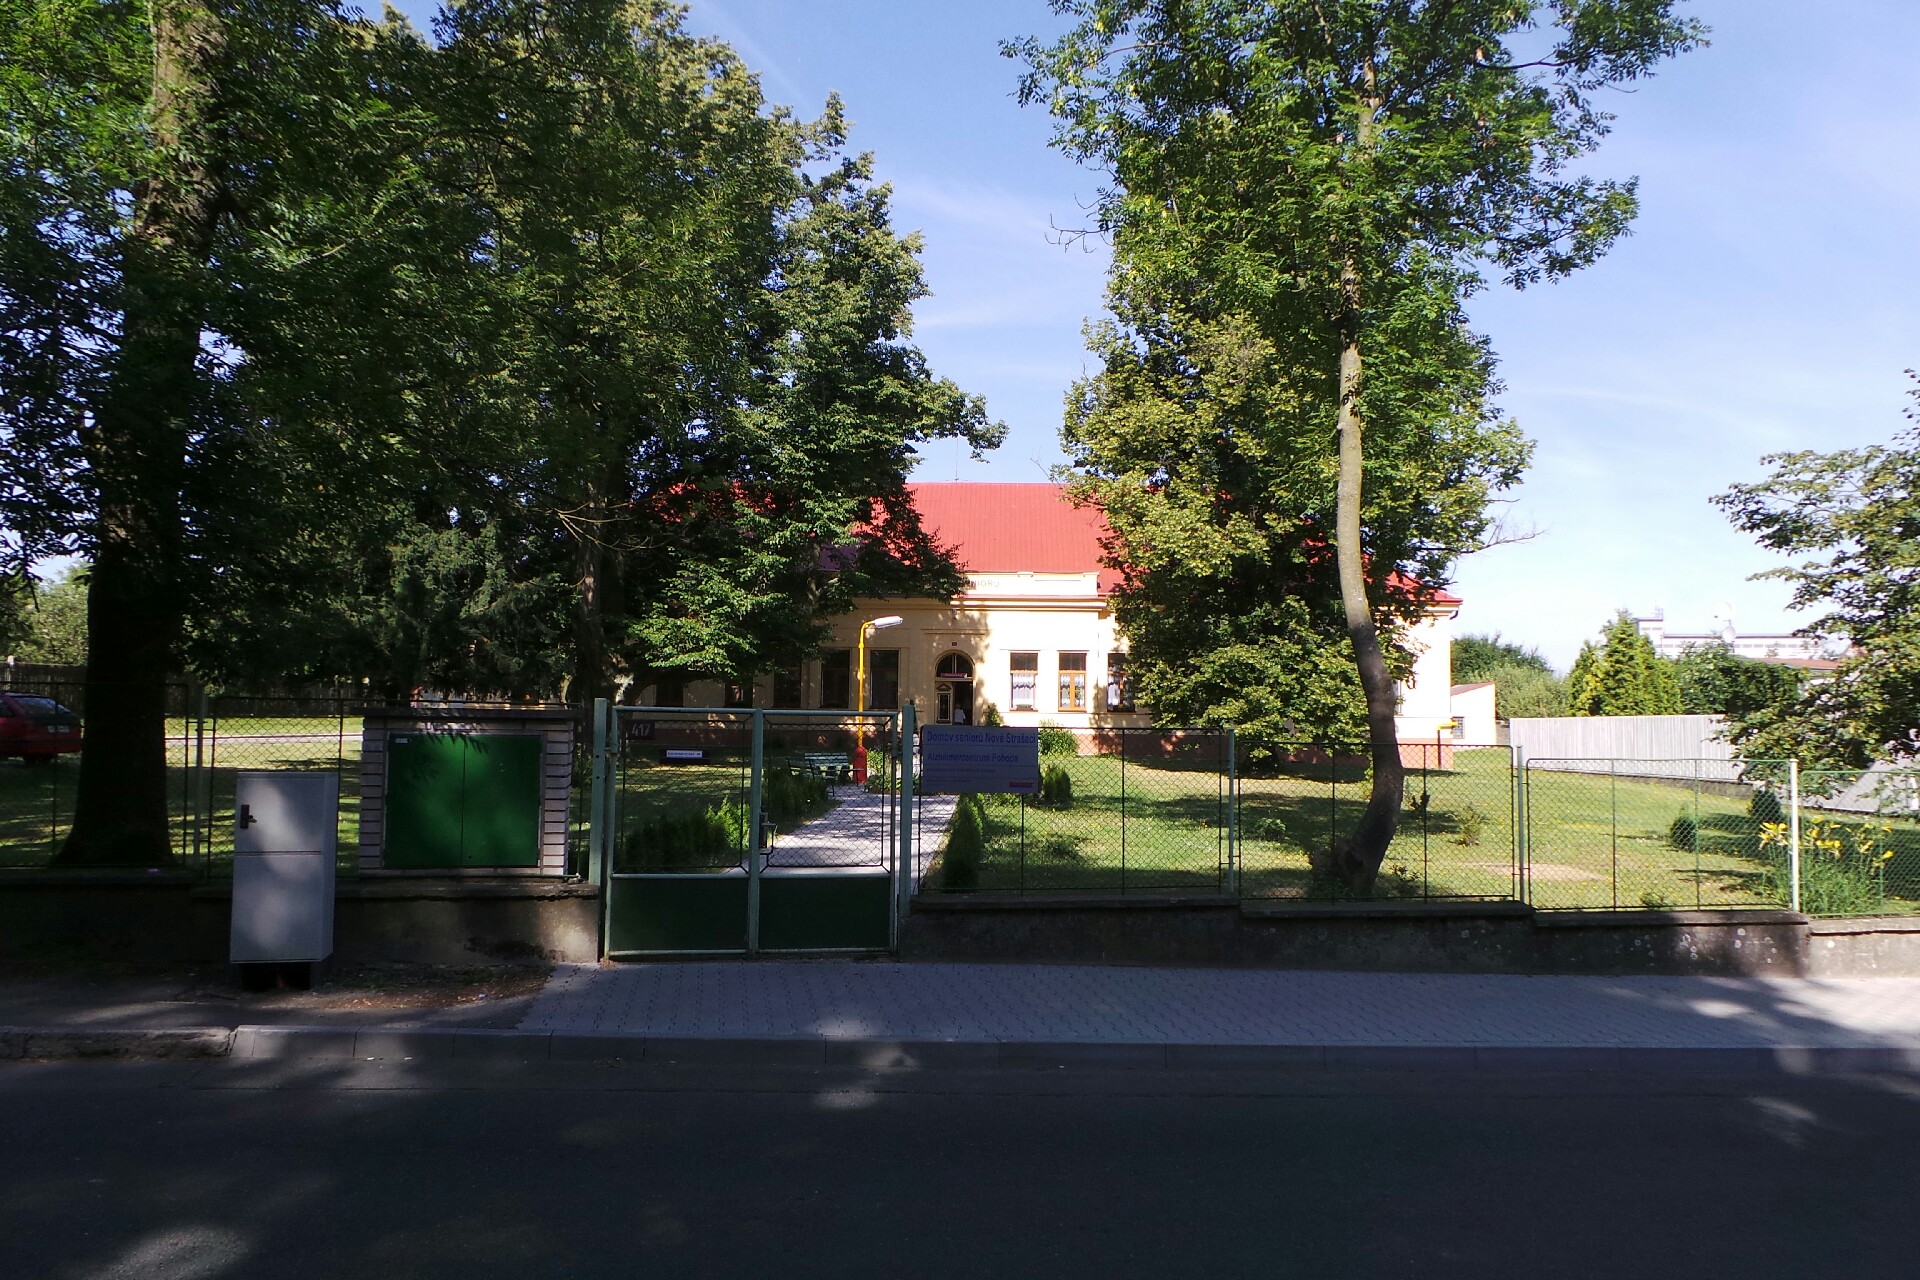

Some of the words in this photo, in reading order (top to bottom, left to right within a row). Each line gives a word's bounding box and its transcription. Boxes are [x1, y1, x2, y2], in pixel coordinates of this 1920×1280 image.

[632, 724, 651, 736] 417
[927, 731, 953, 742] Domov
[986, 732, 1004, 743] Nové
[927, 752, 990, 762] Alzheimercentrum
[992, 754, 1018, 762] Pohoda
